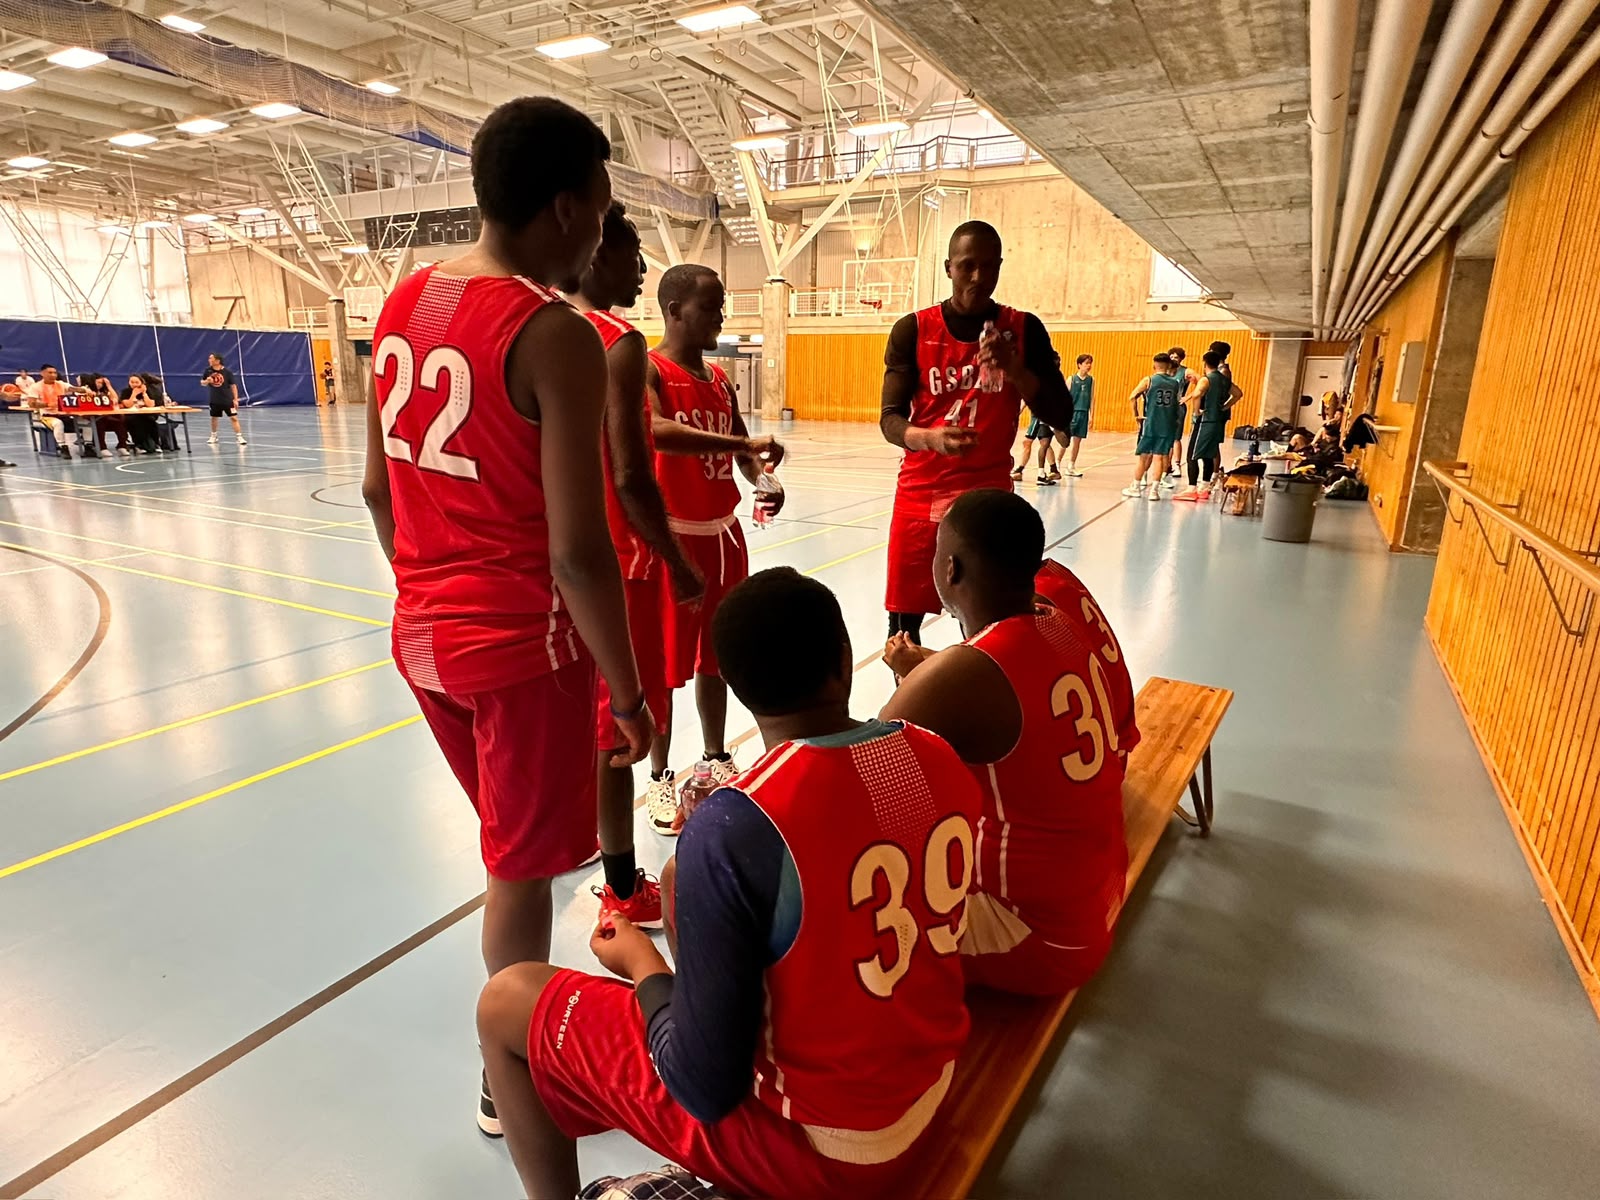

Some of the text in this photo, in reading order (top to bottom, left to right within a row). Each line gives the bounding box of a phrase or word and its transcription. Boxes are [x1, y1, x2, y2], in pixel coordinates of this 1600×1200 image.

[928, 364, 1003, 396] GSB
[62, 396, 77, 406] 17
[93, 395, 110, 406] 09
[373, 331, 479, 482] 22
[944, 398, 978, 428] 41
[1155, 389, 1172, 406] 33
[699, 452, 732, 481] 32
[849, 814, 974, 999] 39
[556, 989, 582, 1049] FOURTEEN
